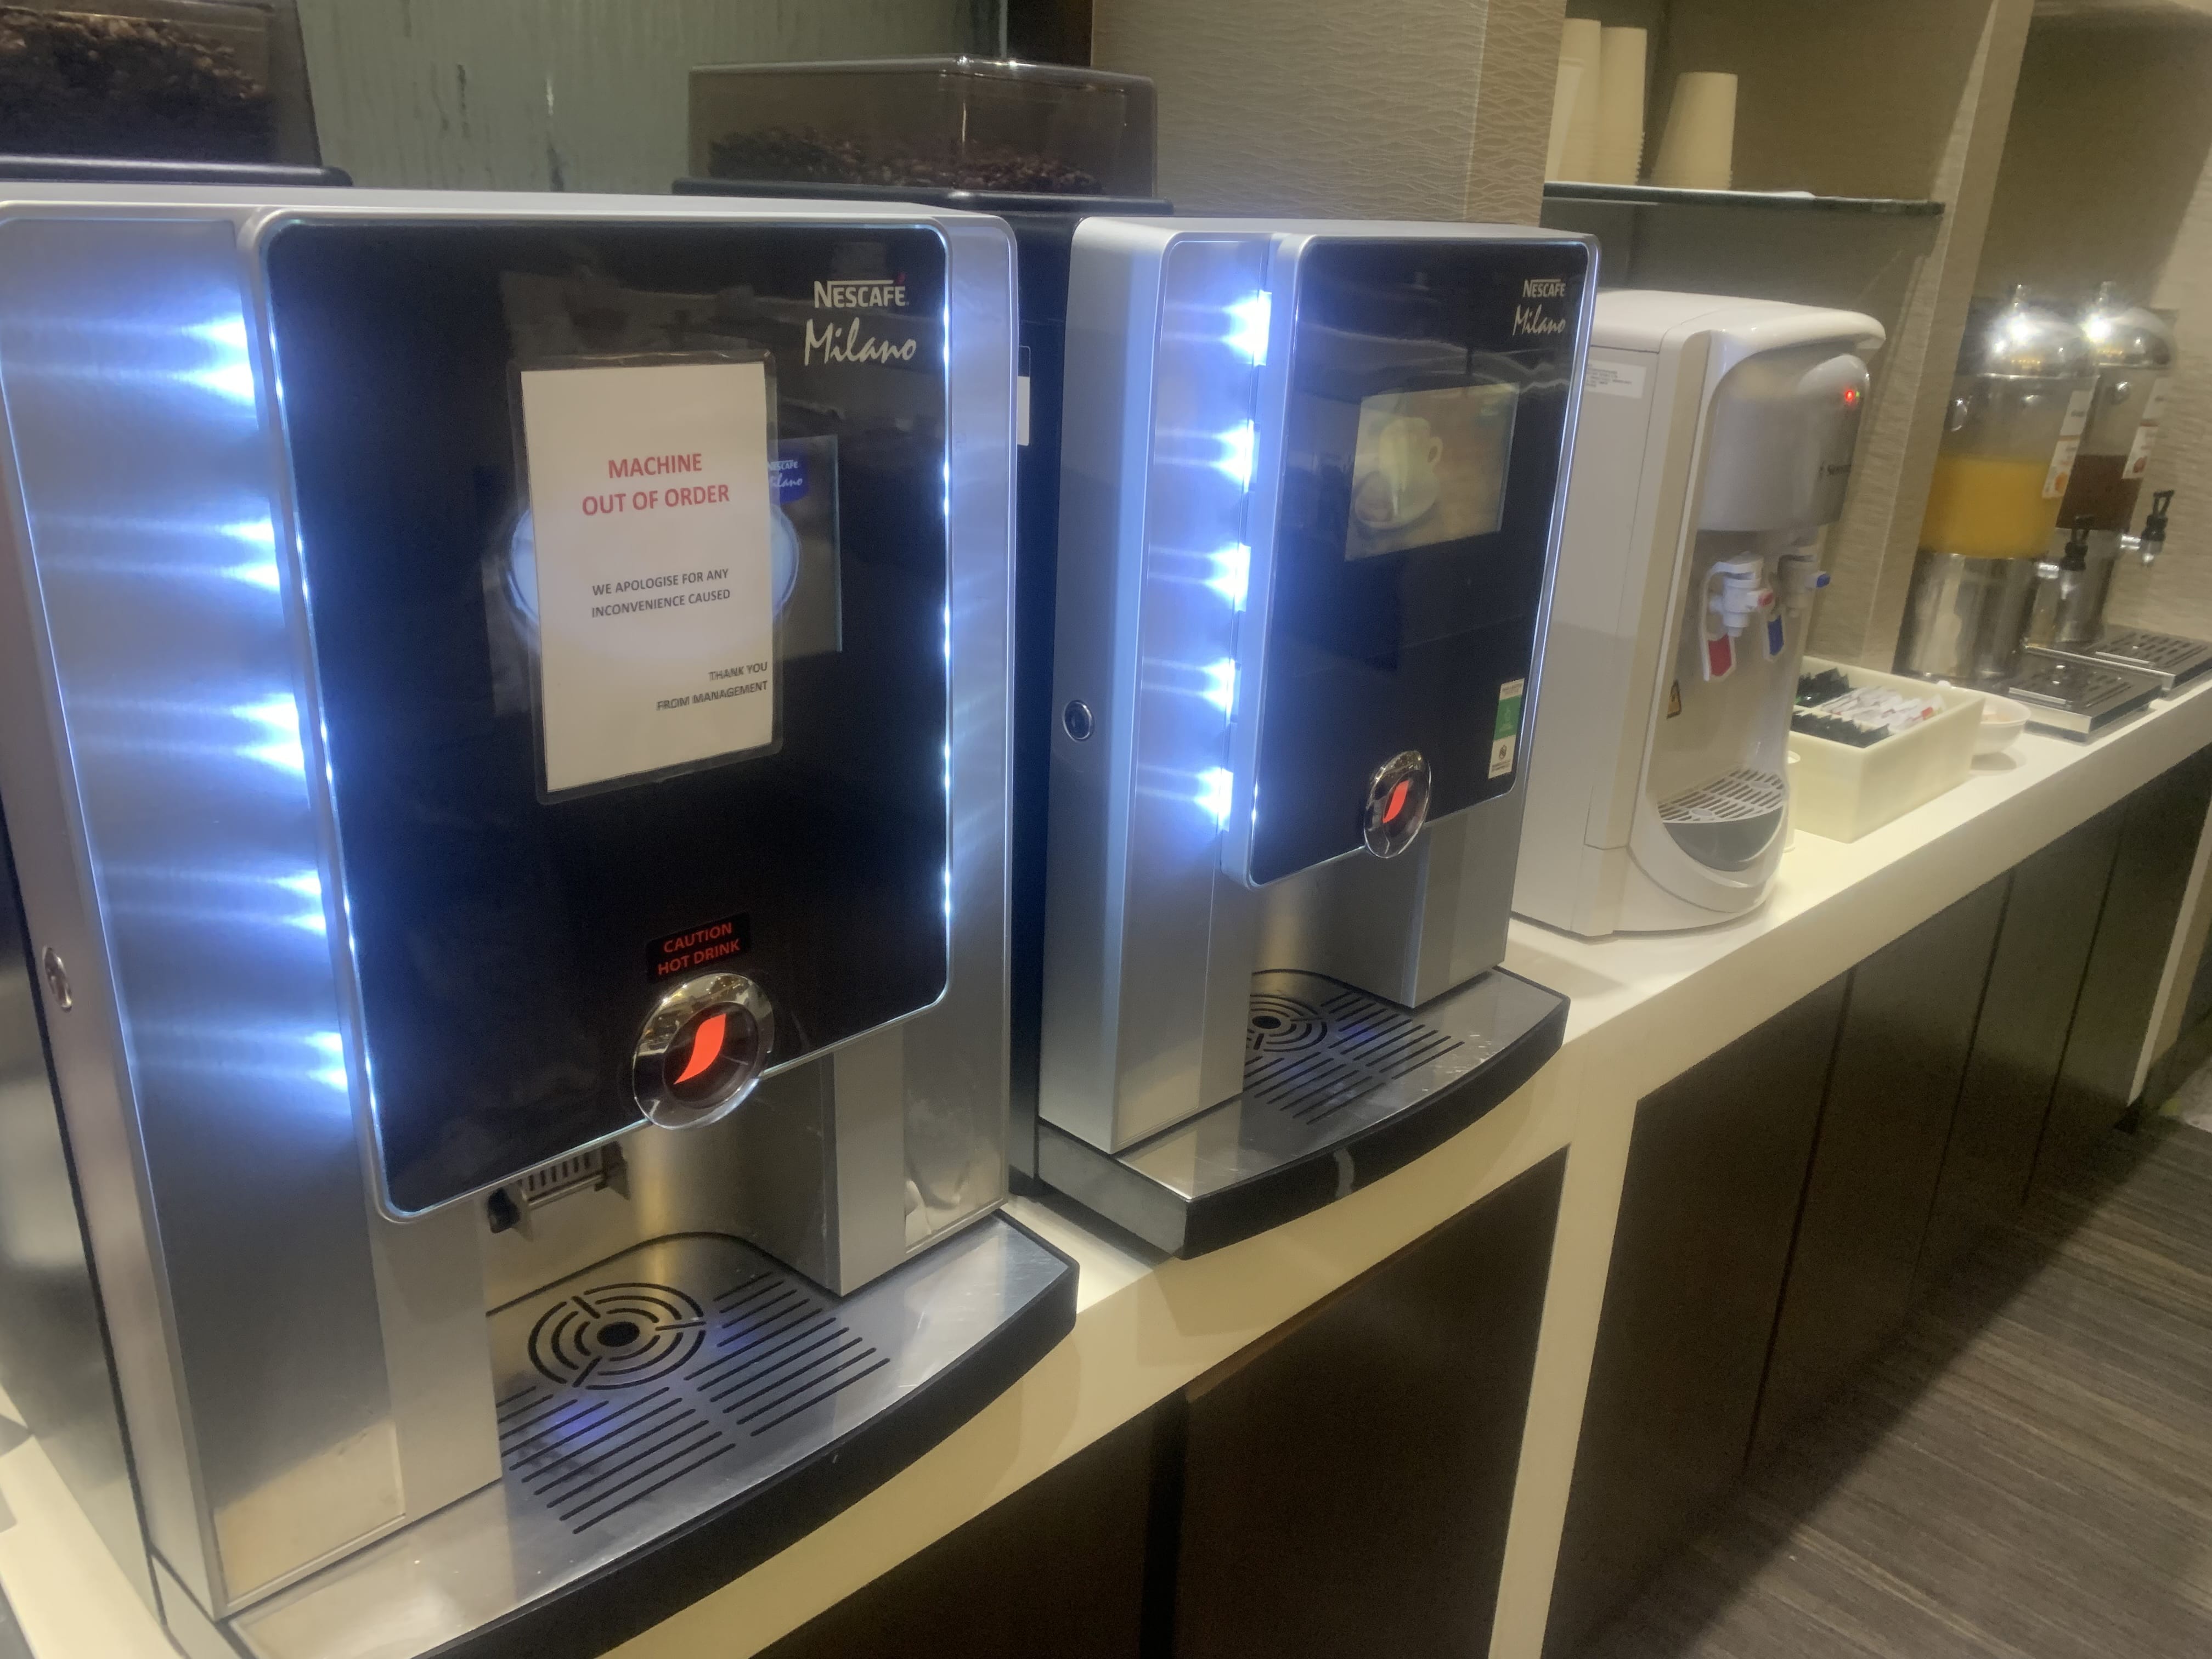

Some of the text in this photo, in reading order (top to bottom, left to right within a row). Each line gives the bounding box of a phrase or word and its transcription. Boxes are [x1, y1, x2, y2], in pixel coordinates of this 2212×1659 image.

[1513, 304, 1566, 336] Milano
[804, 317, 917, 366] Milano
[608, 453, 702, 478] MACHINE
[582, 484, 730, 516] OUT OF ORDER
[592, 568, 729, 596] WE APOLOGISE FOR ANY
[592, 589, 730, 618] INCONVENIENCE CAUSED
[708, 662, 768, 681] THANK YOU
[656, 681, 768, 711] FROM MANAGEMENT
[663, 922, 732, 953] CAUTION
[658, 939, 740, 975] HOT DRINK
